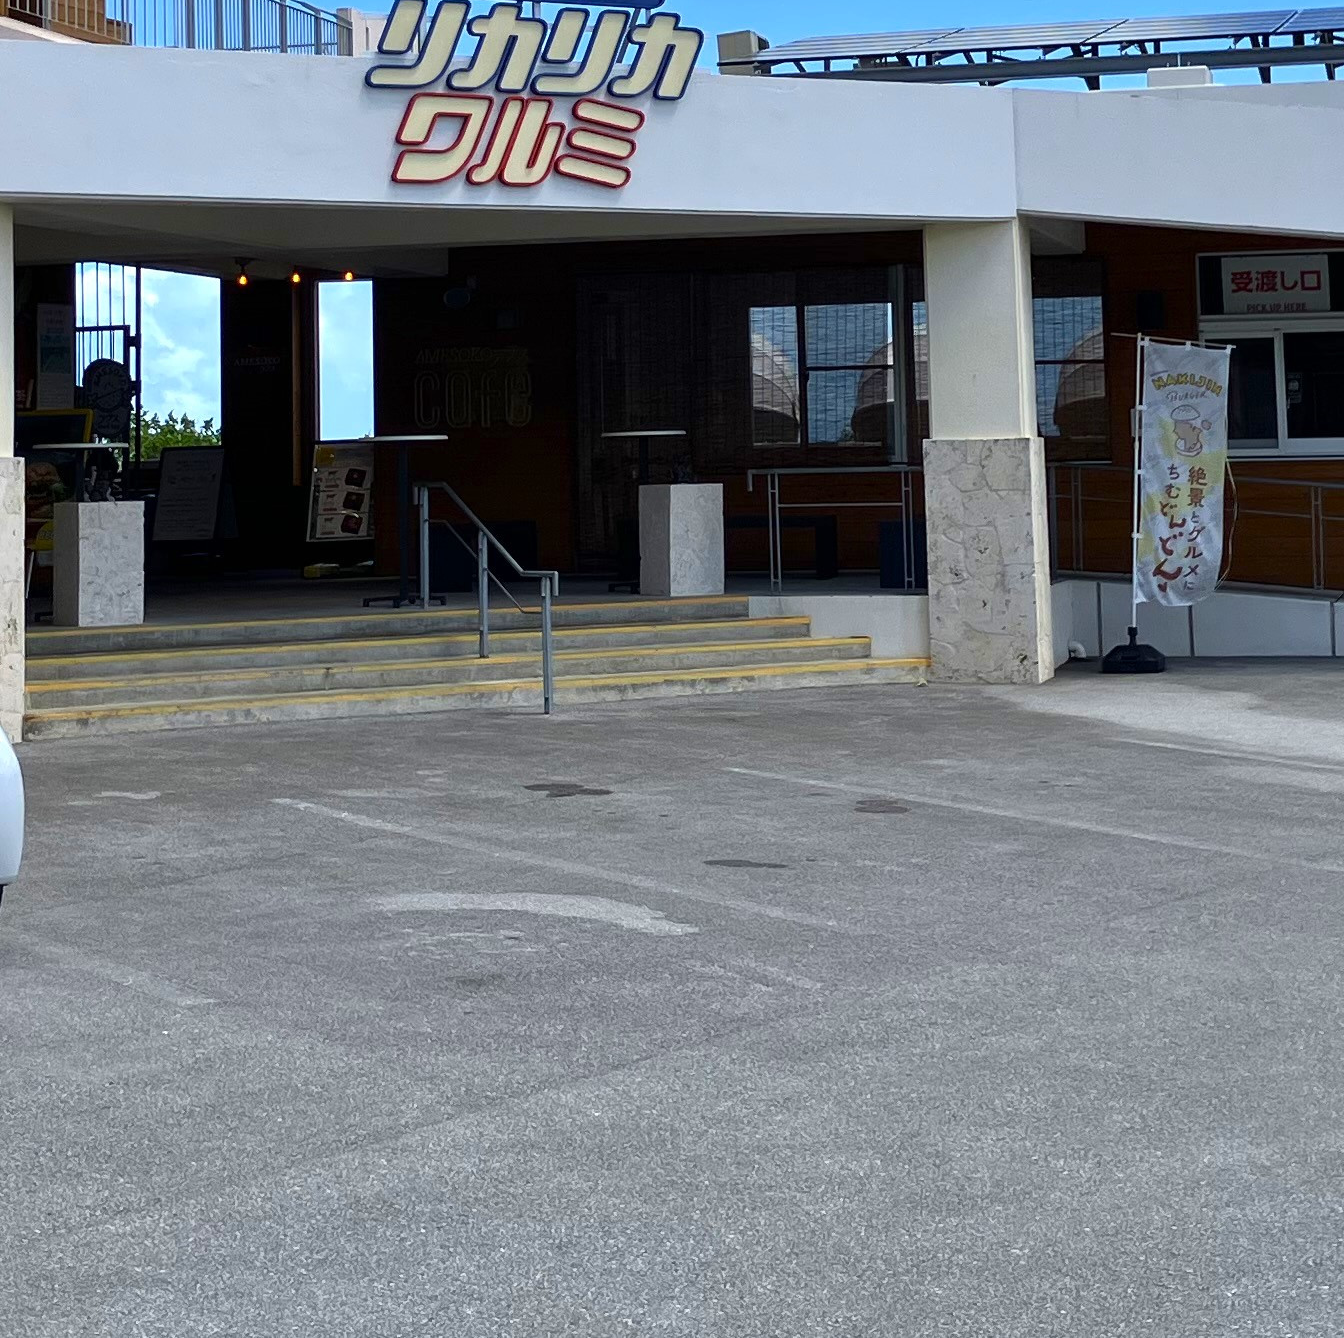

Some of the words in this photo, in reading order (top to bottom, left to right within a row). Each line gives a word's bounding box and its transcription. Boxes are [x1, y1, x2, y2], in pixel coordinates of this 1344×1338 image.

[391, 92, 646, 189] ワルミ
[1231, 270, 1321, 293] 受渡し口
[1283, 302, 1307, 312] HERE
[1151, 372, 1223, 397] NAKIJIN
[1183, 465, 1209, 592] 絶景とグルメに
